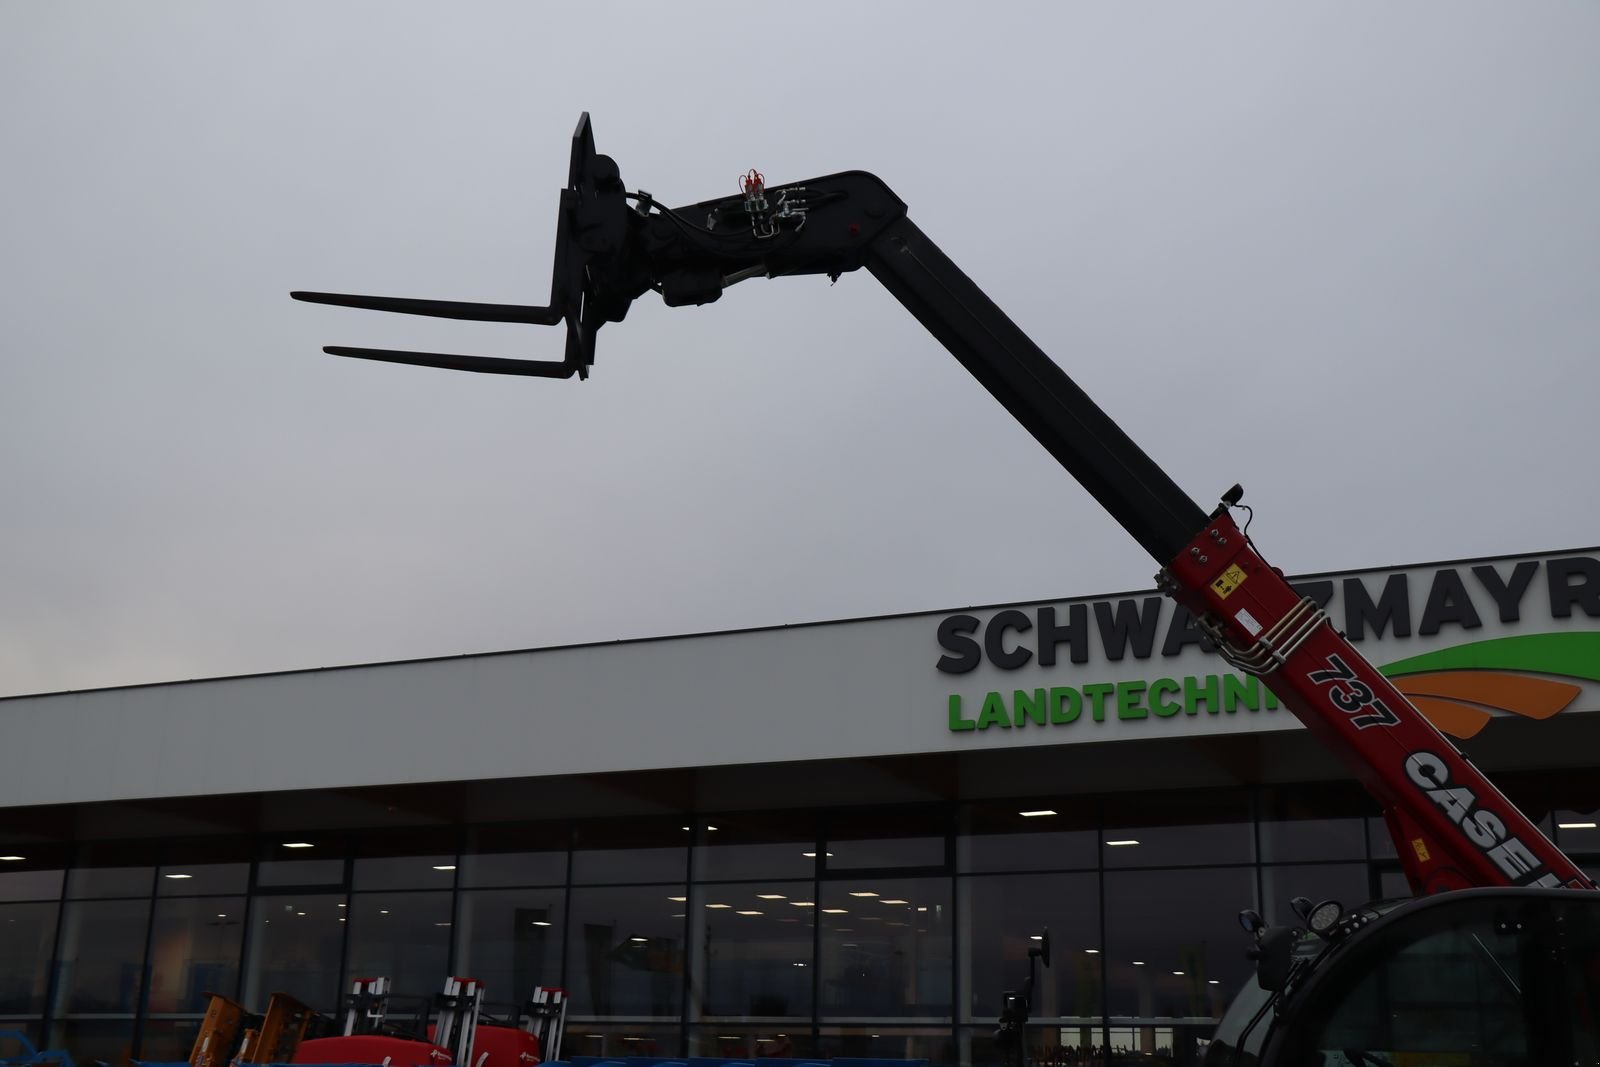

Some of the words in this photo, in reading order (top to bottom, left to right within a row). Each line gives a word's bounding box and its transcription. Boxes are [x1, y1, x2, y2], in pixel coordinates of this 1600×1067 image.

[936, 557, 1600, 674] SCHWAMAYR
[1307, 653, 1401, 730] 737
[1405, 751, 1542, 880] CASE
